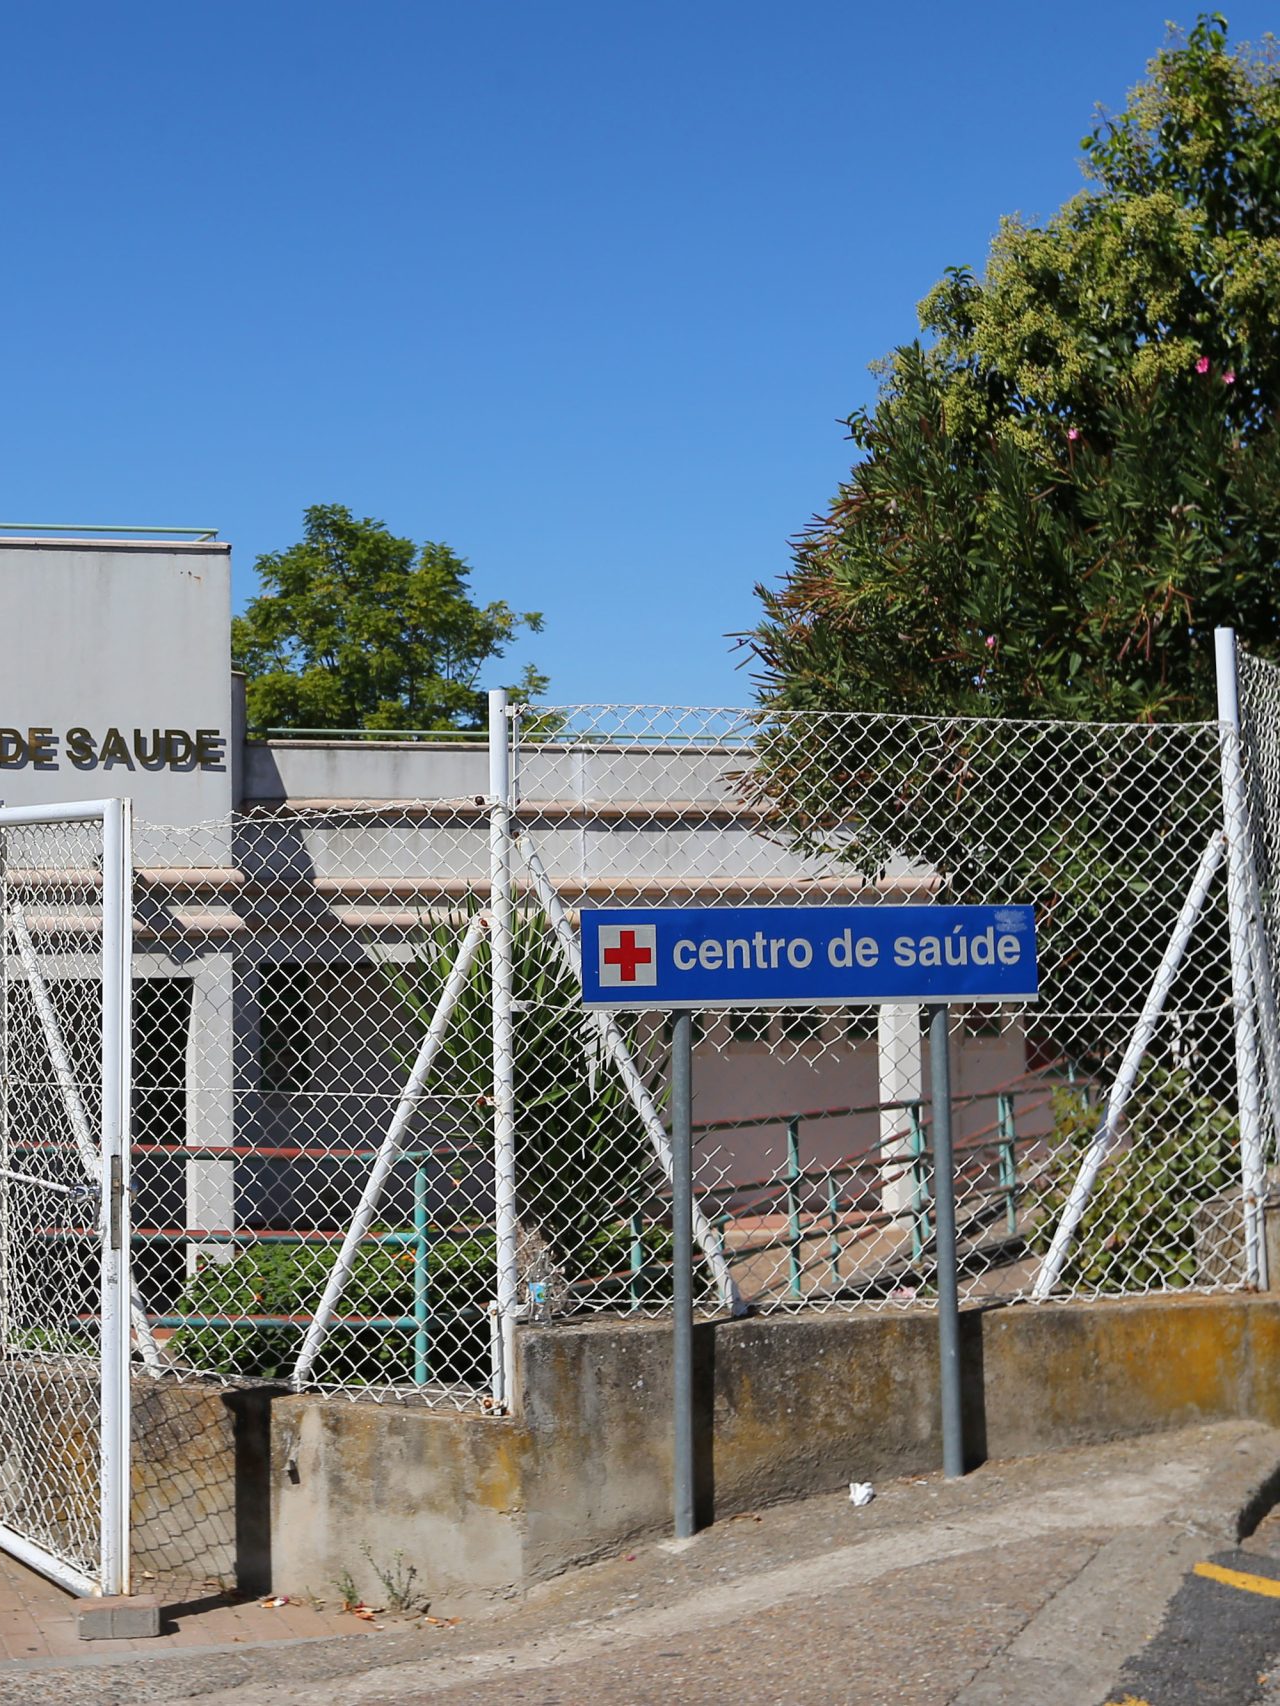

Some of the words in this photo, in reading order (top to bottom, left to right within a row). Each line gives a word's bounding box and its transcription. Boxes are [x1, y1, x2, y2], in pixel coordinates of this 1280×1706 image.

[66, 727, 220, 763] SAUDE
[673, 931, 813, 970] centro
[827, 928, 879, 968] de
[894, 925, 1020, 967] saúde
